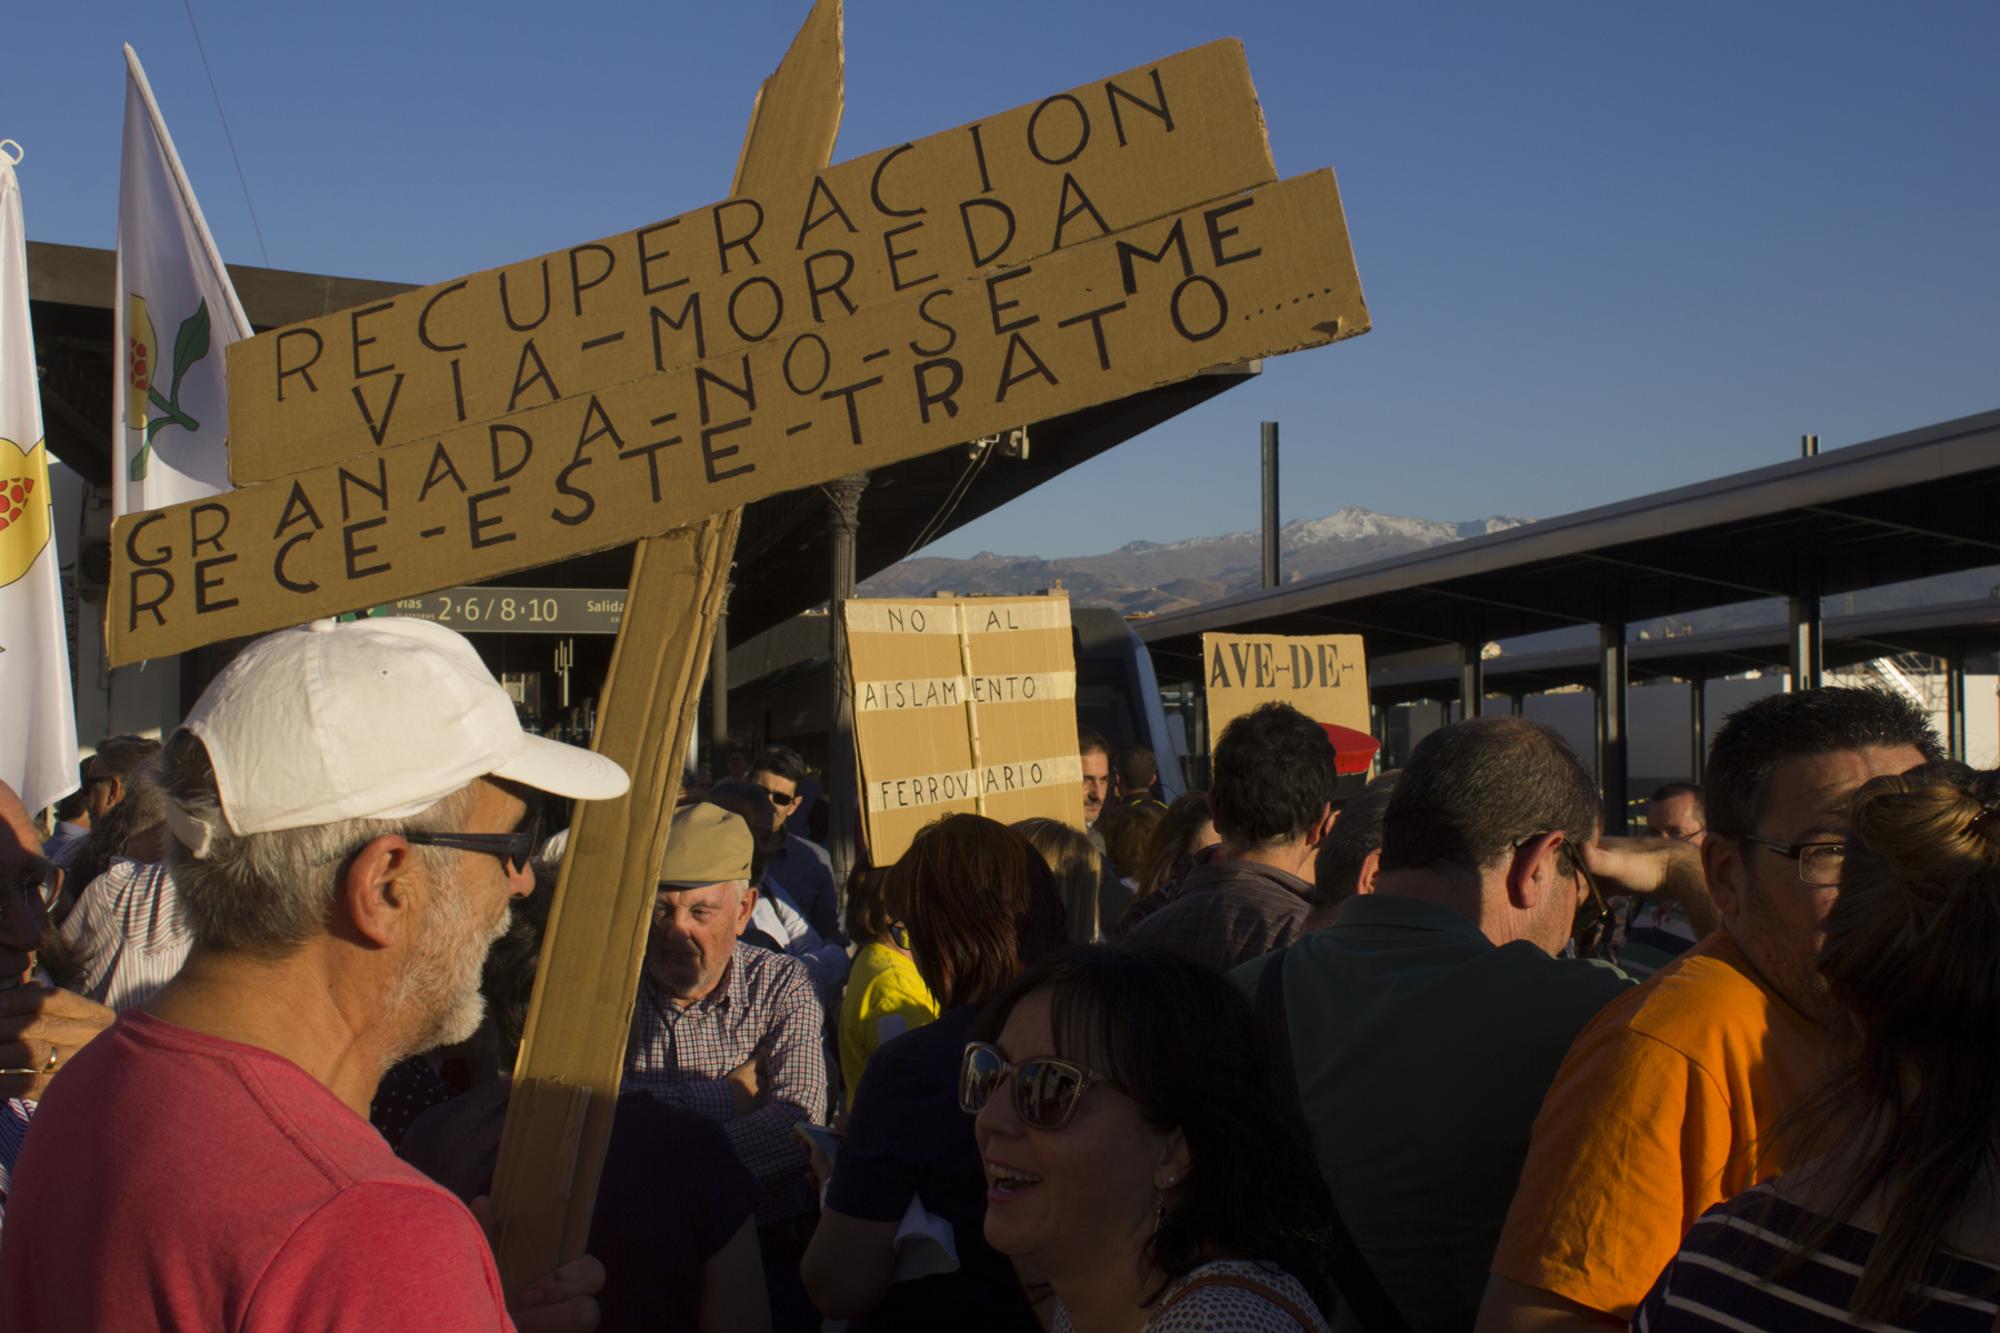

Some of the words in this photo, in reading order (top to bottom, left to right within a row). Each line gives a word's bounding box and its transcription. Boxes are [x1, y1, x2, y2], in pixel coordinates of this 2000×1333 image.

[277, 68, 1175, 402] RECUPERACION
[1115, 197, 1262, 295] ME
[888, 608, 926, 633] NO
[985, 609, 1019, 632] AL
